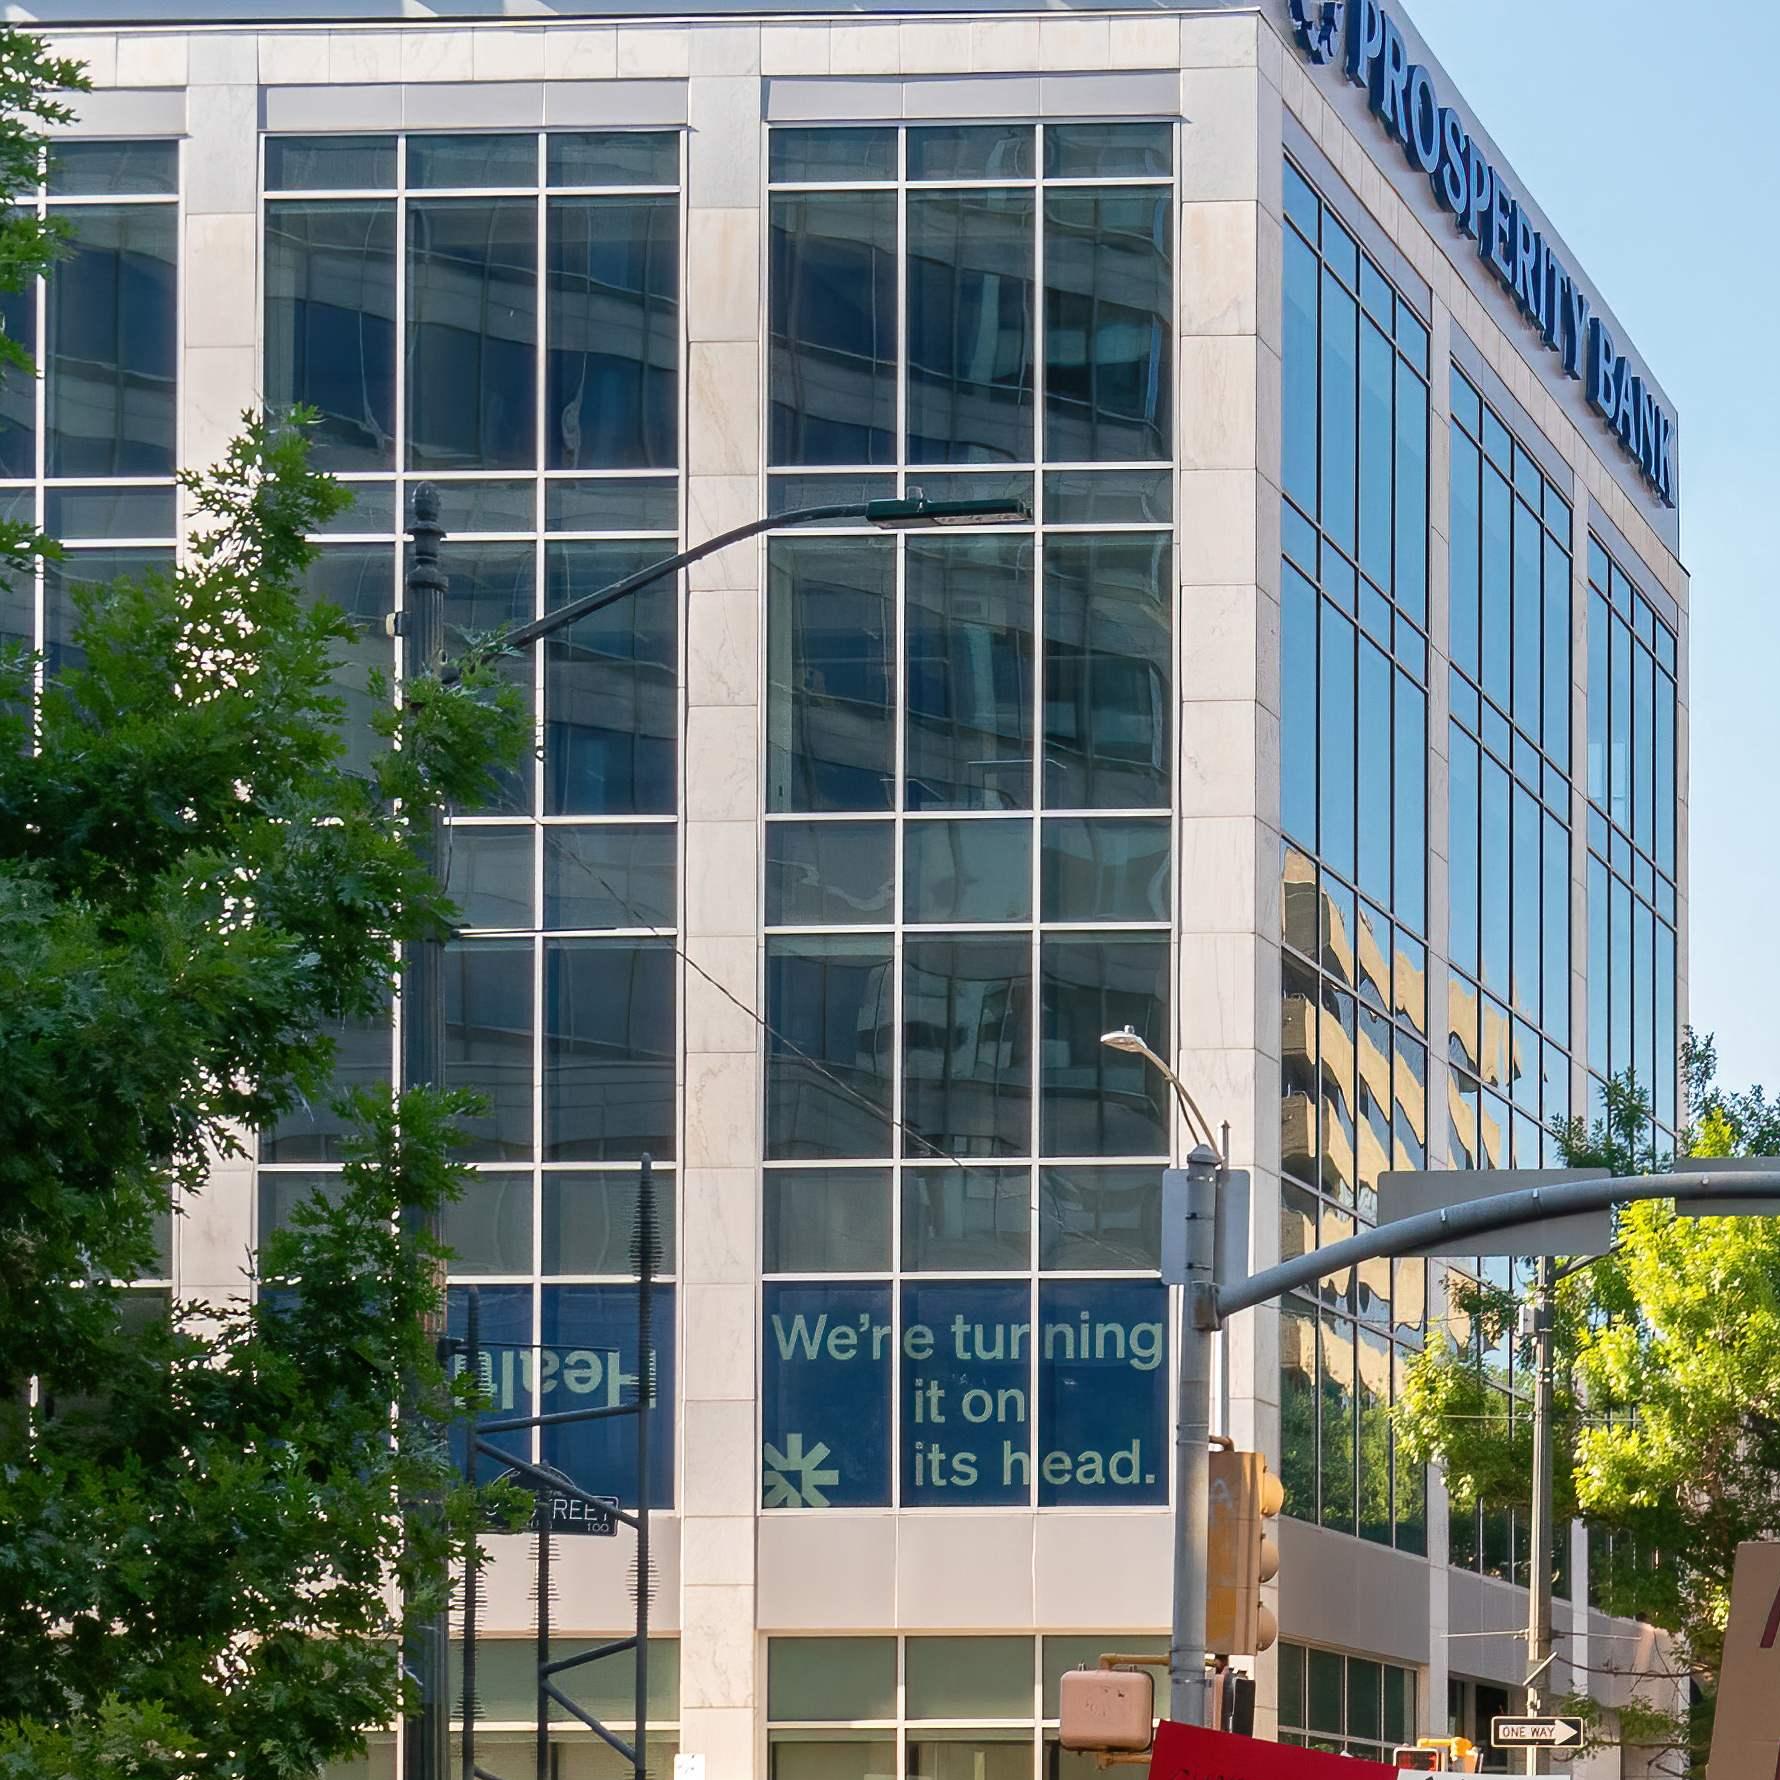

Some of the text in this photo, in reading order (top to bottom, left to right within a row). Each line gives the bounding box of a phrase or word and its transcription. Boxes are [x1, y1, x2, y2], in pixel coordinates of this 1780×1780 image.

[1587, 317, 1676, 508] BANK
[771, 1311, 1163, 1370] We're turning
[914, 1379, 1026, 1424] it on
[914, 1438, 1156, 1486] its head.
[1502, 1725, 1554, 1739] ONE WAY
